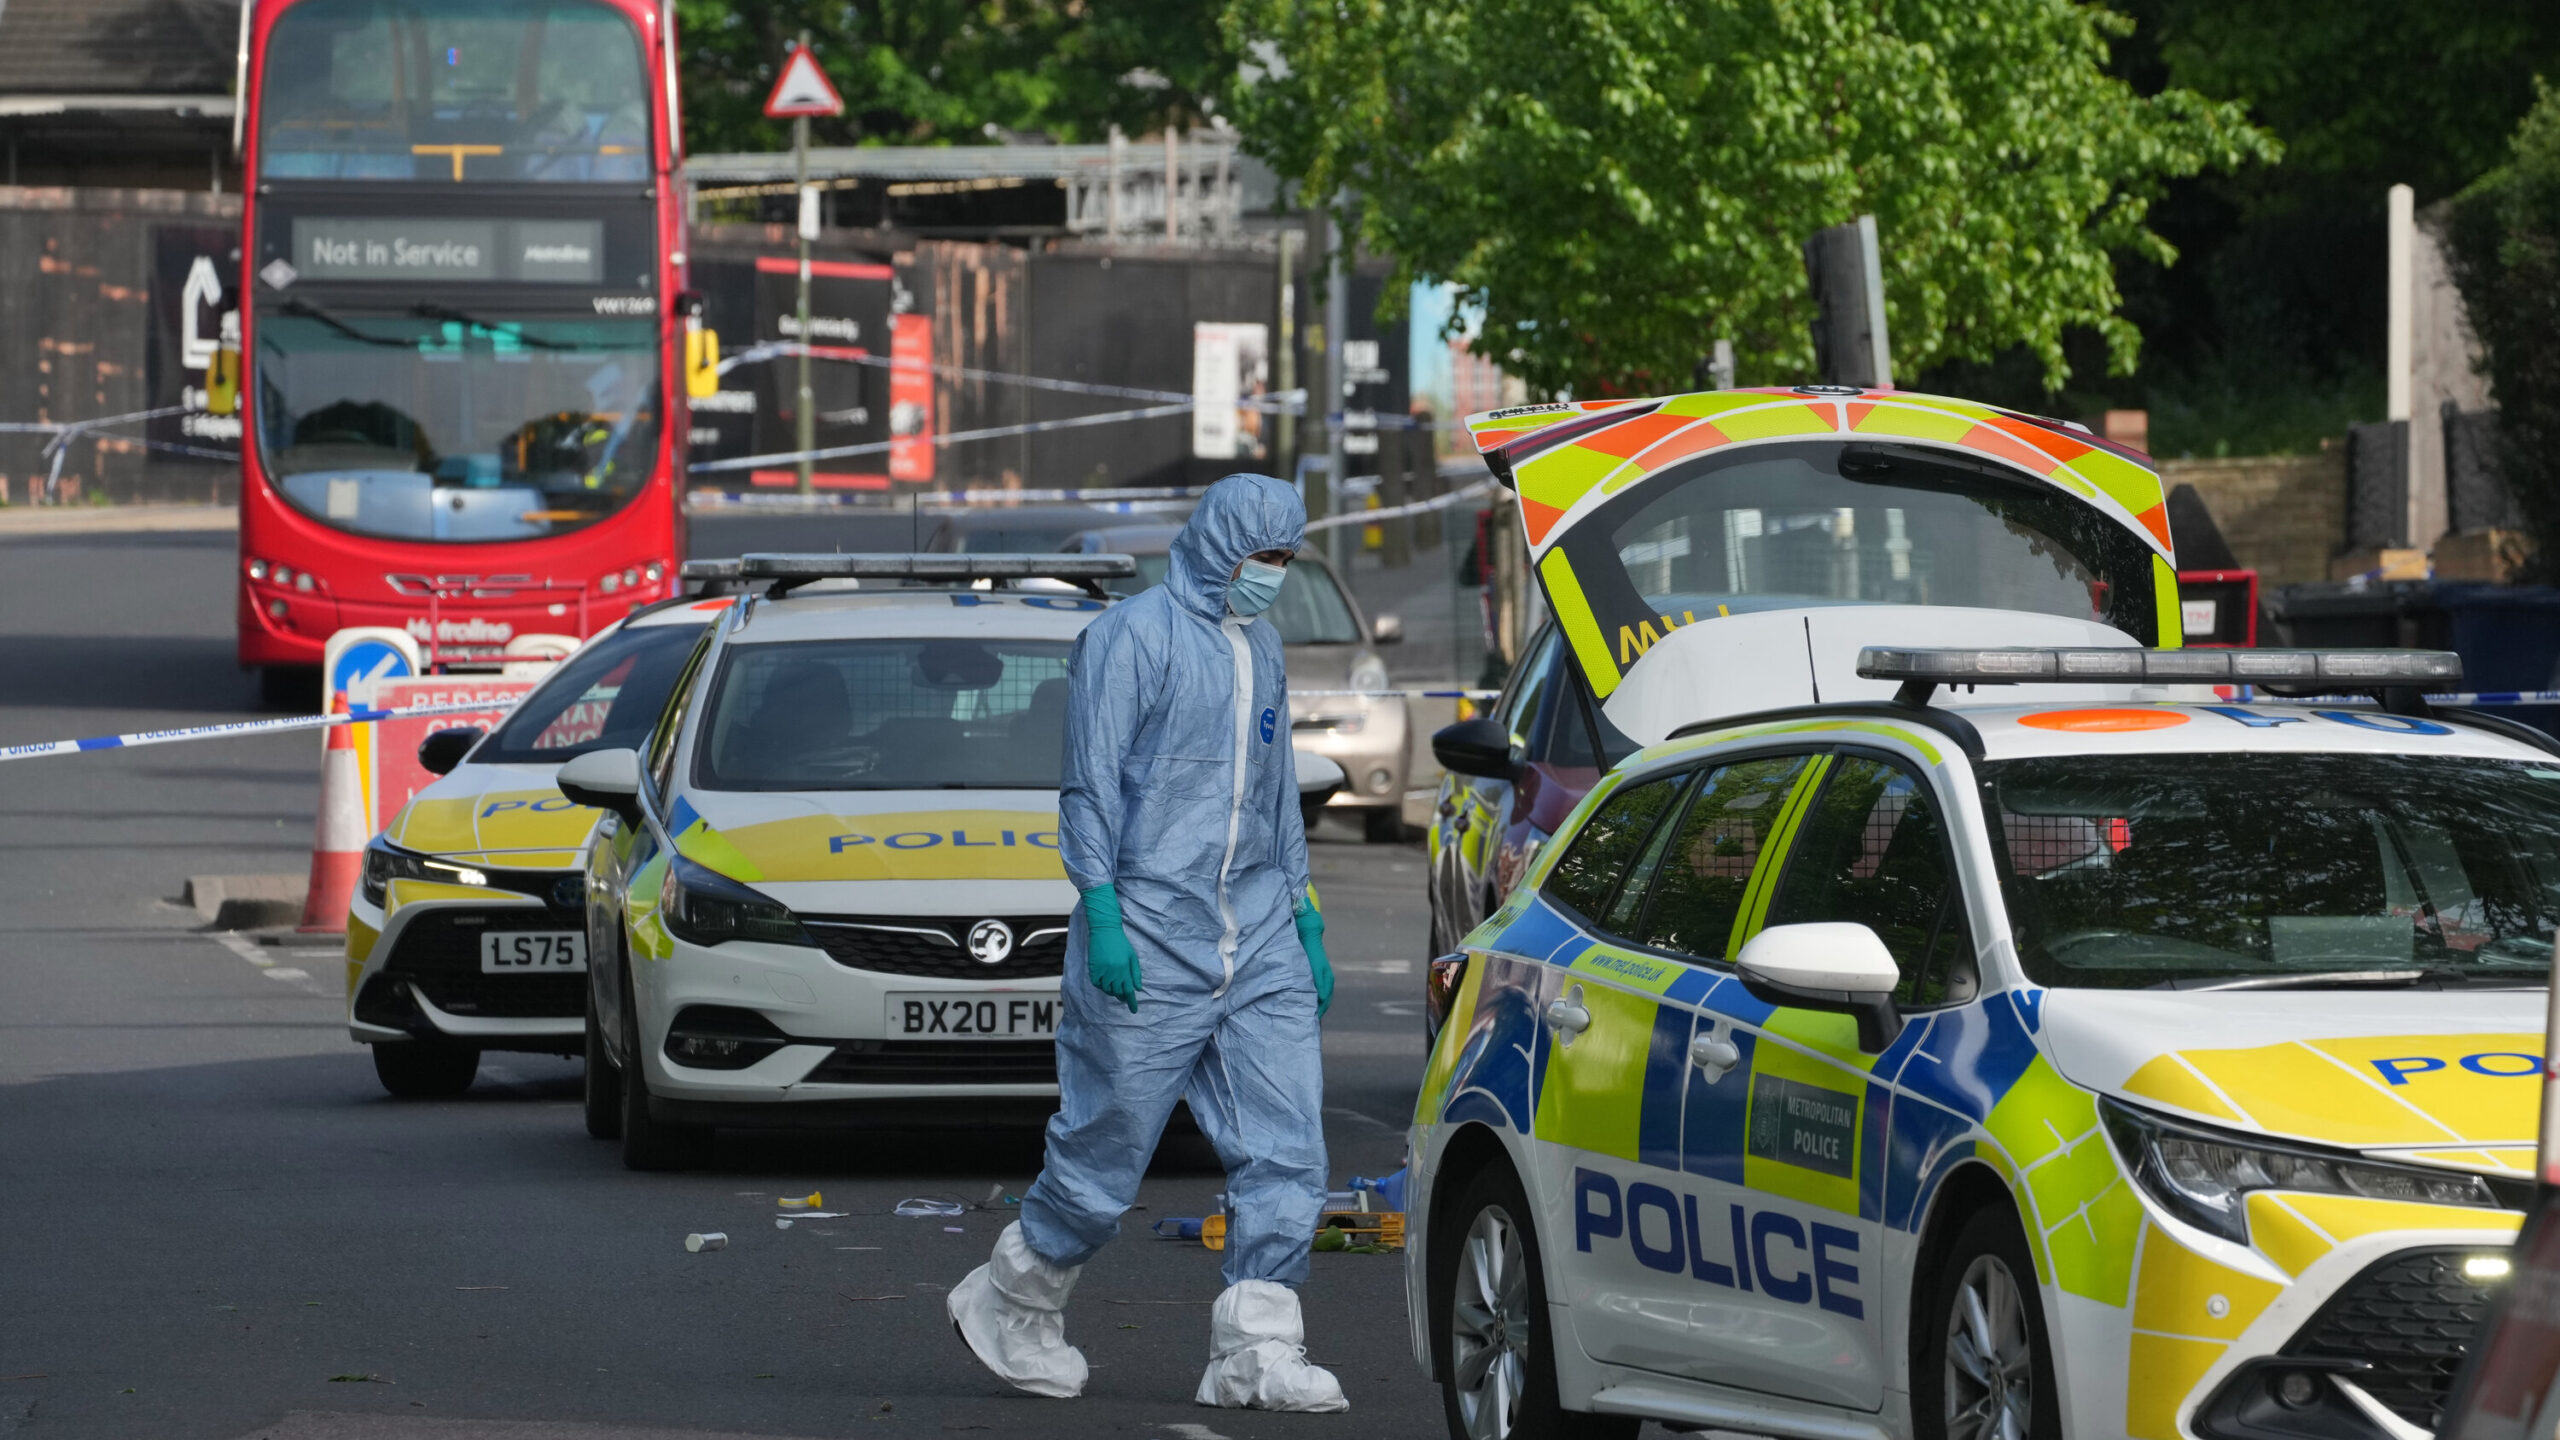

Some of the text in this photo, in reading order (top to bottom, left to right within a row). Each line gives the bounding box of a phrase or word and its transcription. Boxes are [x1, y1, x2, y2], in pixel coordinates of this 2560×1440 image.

[313, 237, 480, 267] Not in Service
[492, 936, 574, 967] LS75
[903, 1000, 997, 1033] BX20
[1787, 1096, 1851, 1128] METROPOLITAN
[1793, 1128, 1840, 1160] POLICE
[1575, 1166, 1865, 1321] POLICE
